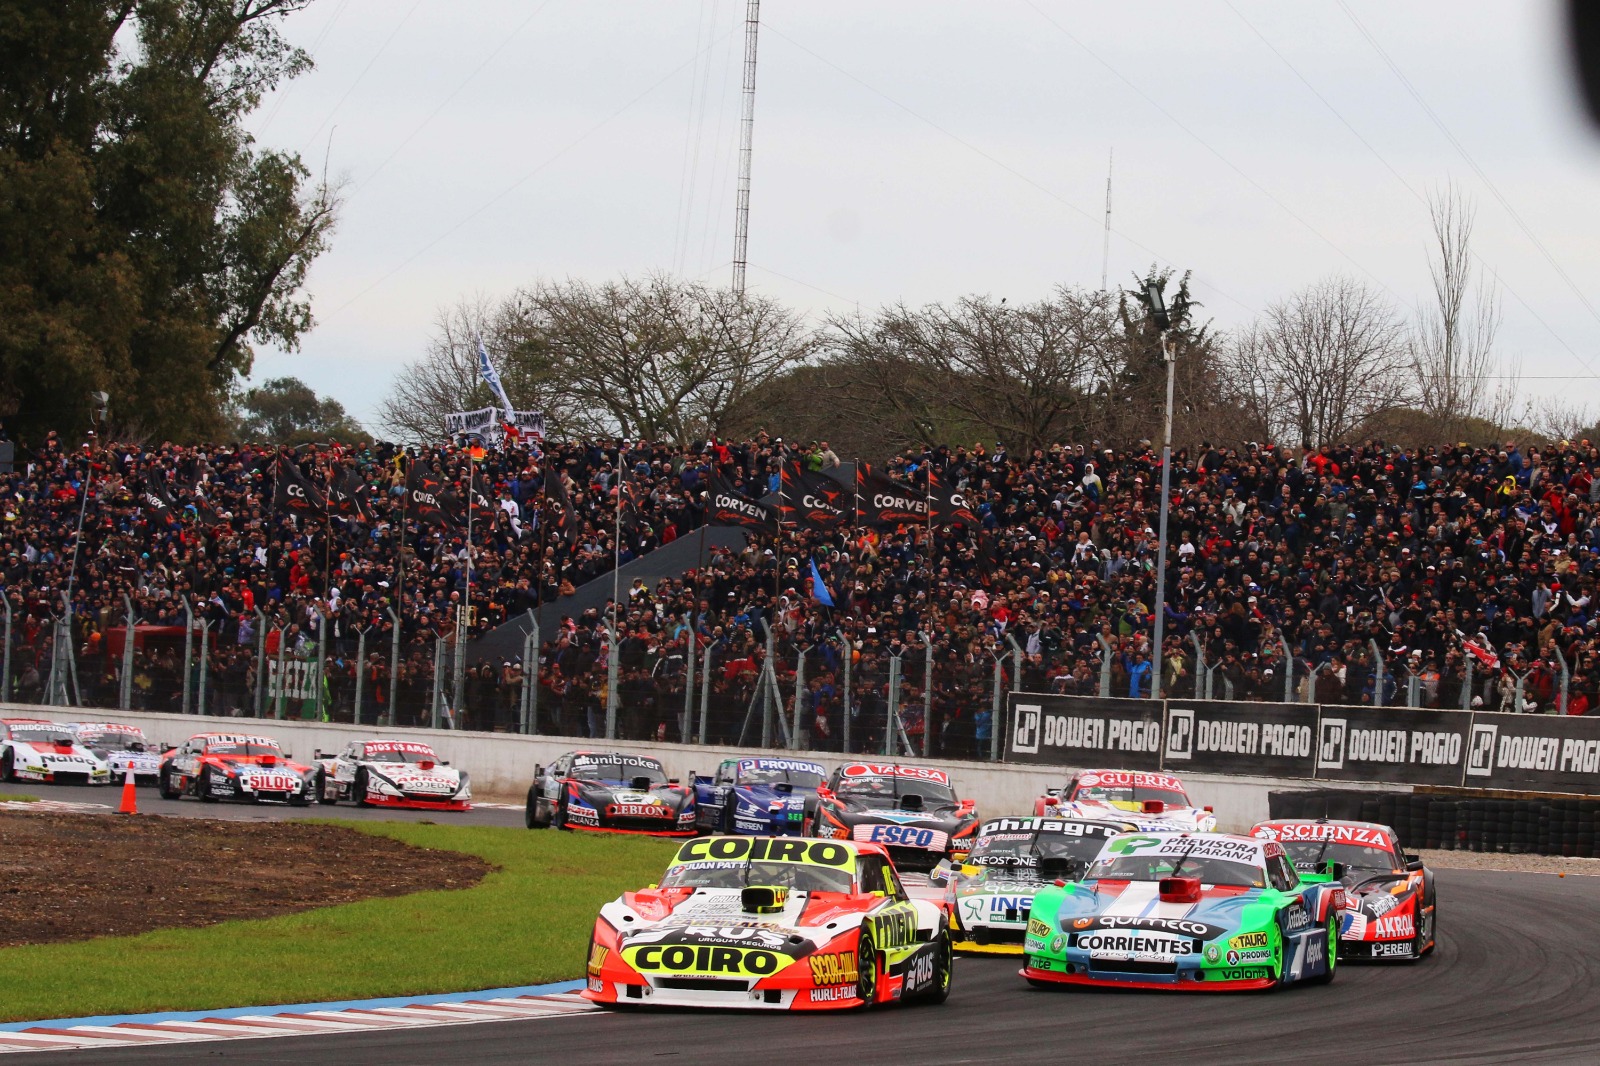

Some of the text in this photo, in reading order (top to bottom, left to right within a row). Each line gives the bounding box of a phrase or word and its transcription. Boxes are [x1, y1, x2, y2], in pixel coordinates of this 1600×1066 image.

[715, 493, 768, 521] CORVEN
[1044, 714, 1105, 749] DOWEN
[1107, 718, 1160, 753] PAGIO
[1197, 719, 1259, 754] DOWEN
[1261, 723, 1312, 757] PAGIO
[366, 743, 390, 753] DIOS
[1348, 728, 1406, 763] DOWEN
[1409, 730, 1463, 765] PAGIO
[1497, 734, 1560, 771] DOWEN
[759, 759, 826, 777] PROVIDUS
[873, 765, 945, 783] TACSA
[250, 775, 295, 789] SILOC
[1100, 772, 1183, 791] GUERRA
[613, 804, 665, 816] LEBLON
[869, 824, 934, 847] ESCO
[1281, 824, 1387, 847] SCIENZA
[678, 838, 849, 866] COIRO
[1165, 837, 1258, 855] PREVISORA
[686, 861, 712, 871] JUAN
[972, 856, 1037, 867] NEOSTONE
[684, 926, 785, 945] RUS
[1375, 914, 1415, 939] AKRON
[741, 940, 782, 951] SEGUROS
[1077, 935, 1192, 955] CORRIENTES
[1238, 932, 1268, 948] TAURO
[1371, 942, 1412, 957] PEREIRA
[634, 945, 778, 975] COIRO
[1241, 949, 1272, 960] PRODINSA
[916, 952, 934, 986] RUS
